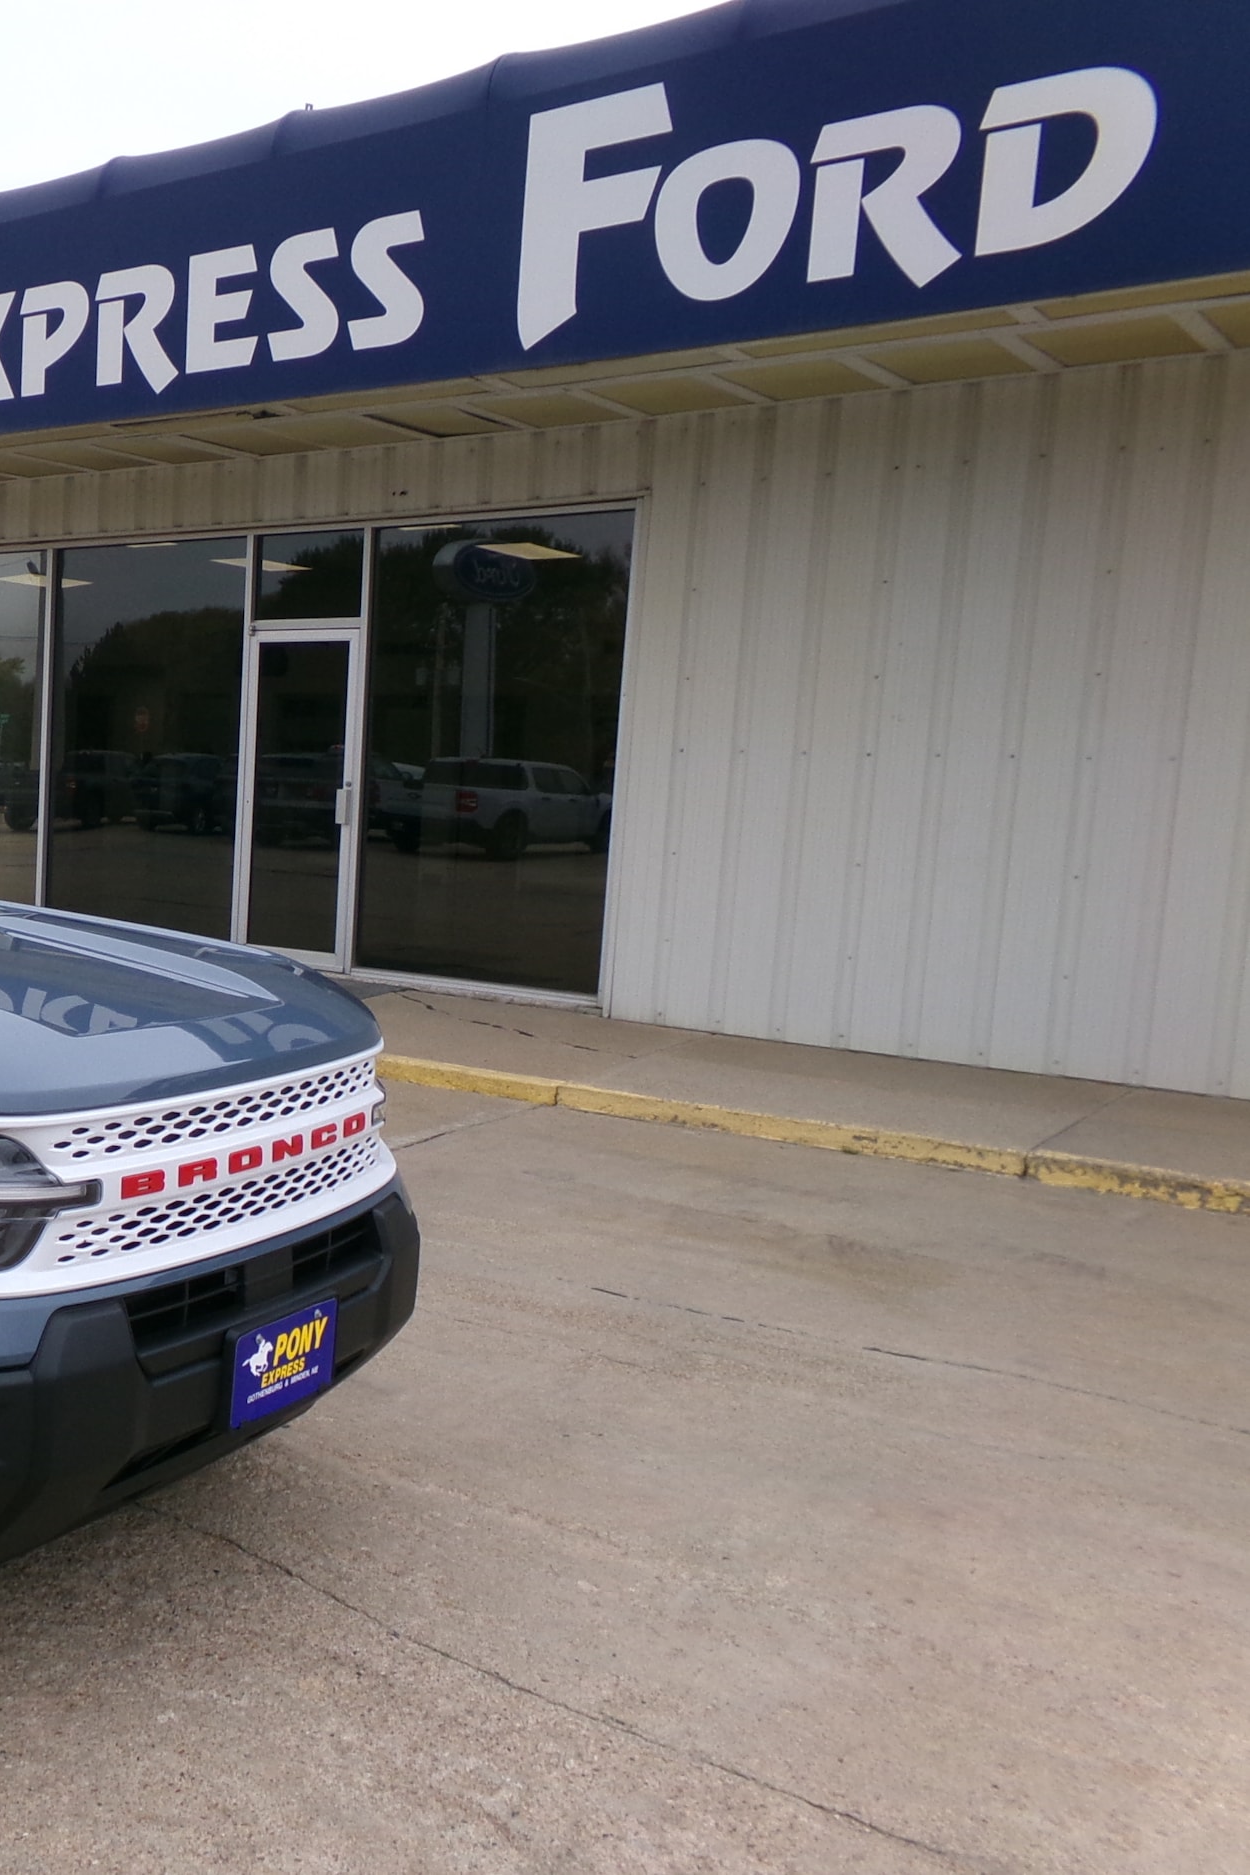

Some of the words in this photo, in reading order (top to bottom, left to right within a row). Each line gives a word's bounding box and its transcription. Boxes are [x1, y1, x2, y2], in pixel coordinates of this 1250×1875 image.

[517, 66, 1158, 351] FORD
[120, 1111, 367, 1200] BRONCO
[261, 1357, 306, 1389] EXPRESS
[272, 1316, 328, 1367] PONY
